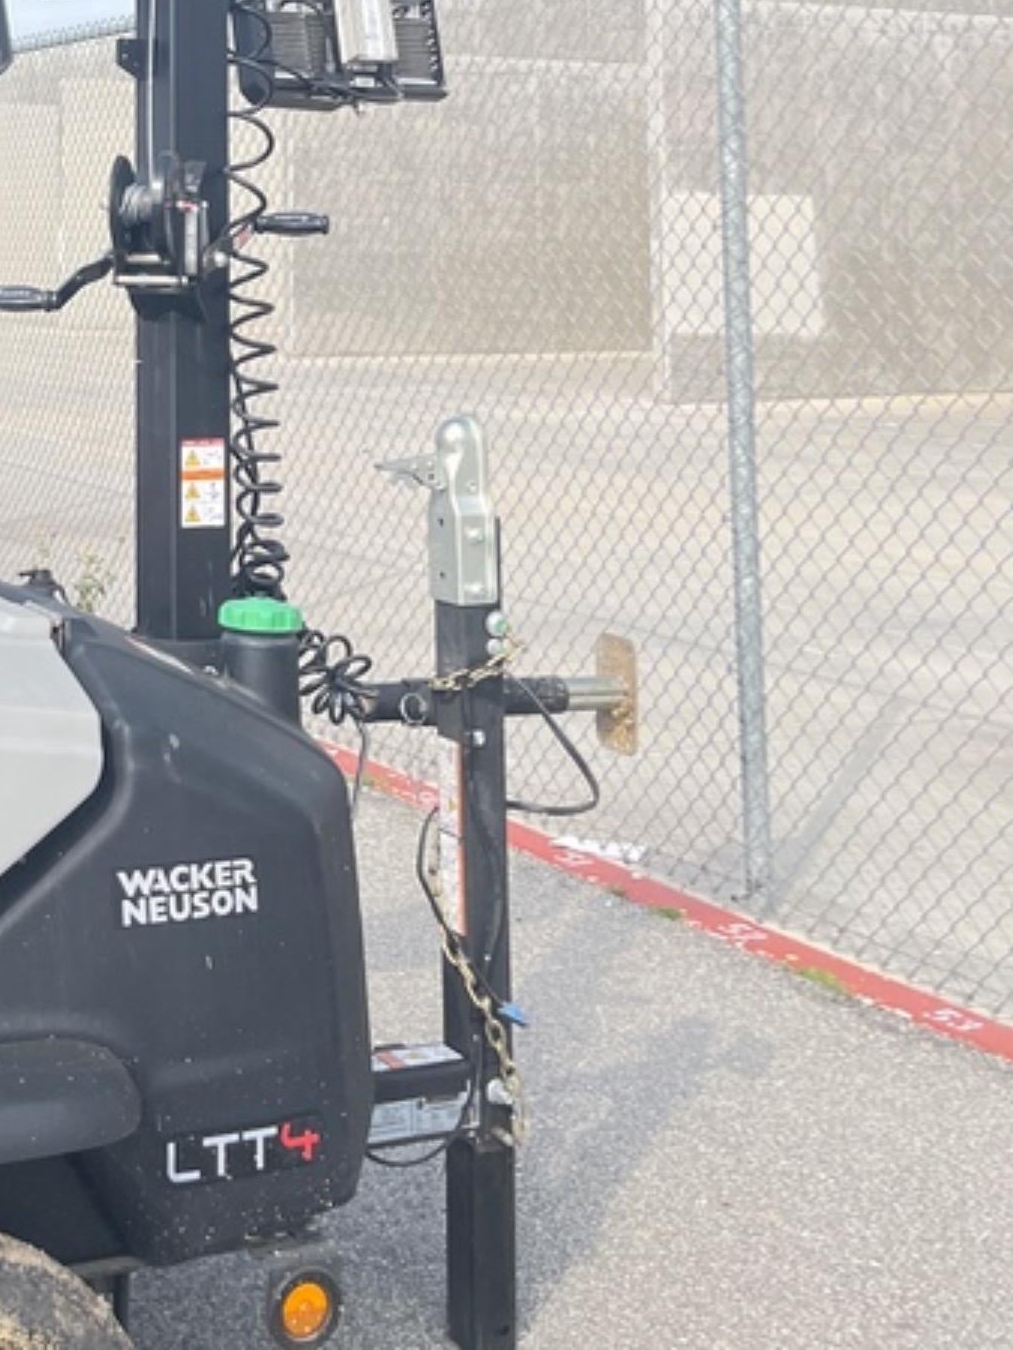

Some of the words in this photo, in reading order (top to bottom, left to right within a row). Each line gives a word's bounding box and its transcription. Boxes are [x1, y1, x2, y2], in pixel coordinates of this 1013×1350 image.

[116, 857, 256, 899] WACKER
[121, 885, 259, 928] NEUSON
[166, 1120, 321, 1184] LTT4
